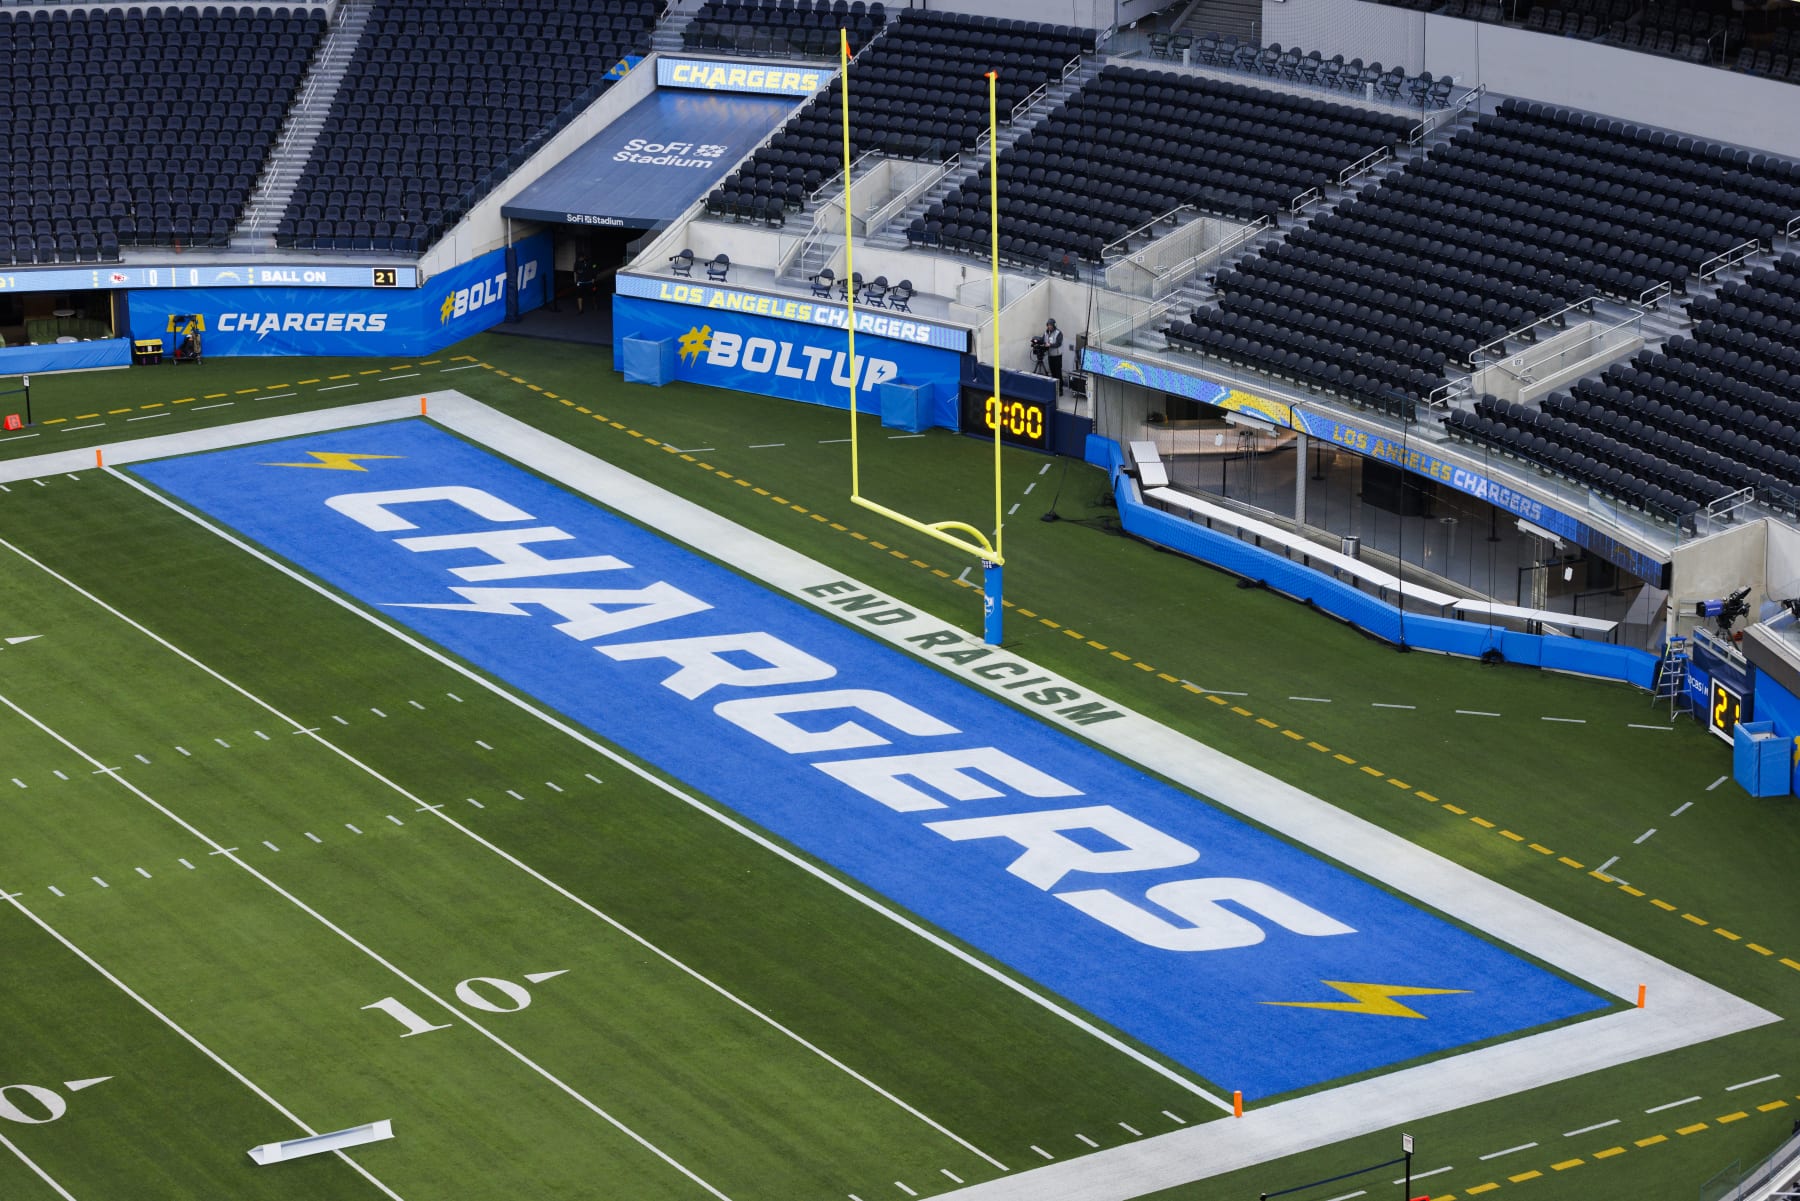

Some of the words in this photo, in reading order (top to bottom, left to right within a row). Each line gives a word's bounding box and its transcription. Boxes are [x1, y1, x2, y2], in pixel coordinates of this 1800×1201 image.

[672, 65, 819, 91] CHARGERS
[613, 151, 713, 168] Stadium
[623, 139, 694, 155] SoFi
[566, 213, 584, 223] SoFi
[592, 216, 624, 226] Stadium
[149, 269, 158, 287] 0
[190, 268, 199, 287] 0
[261, 270, 300, 283] BALL
[303, 270, 327, 283] ON
[375, 271, 395, 284] 21
[660, 283, 704, 304] LOS
[707, 290, 813, 322] ANGELES
[813, 306, 931, 342] CHARGERS
[217, 313, 388, 342] CHARGERS
[985, 396, 1042, 439] 0:00
[1332, 425, 1368, 450] LOS
[1371, 439, 1452, 482] ANGELES
[1453, 469, 1543, 522] CHARGERS
[801, 580, 917, 626] END
[903, 629, 1127, 727] RACISM
[324, 485, 1358, 953] CHARGERS
[360, 975, 532, 1038] 10
